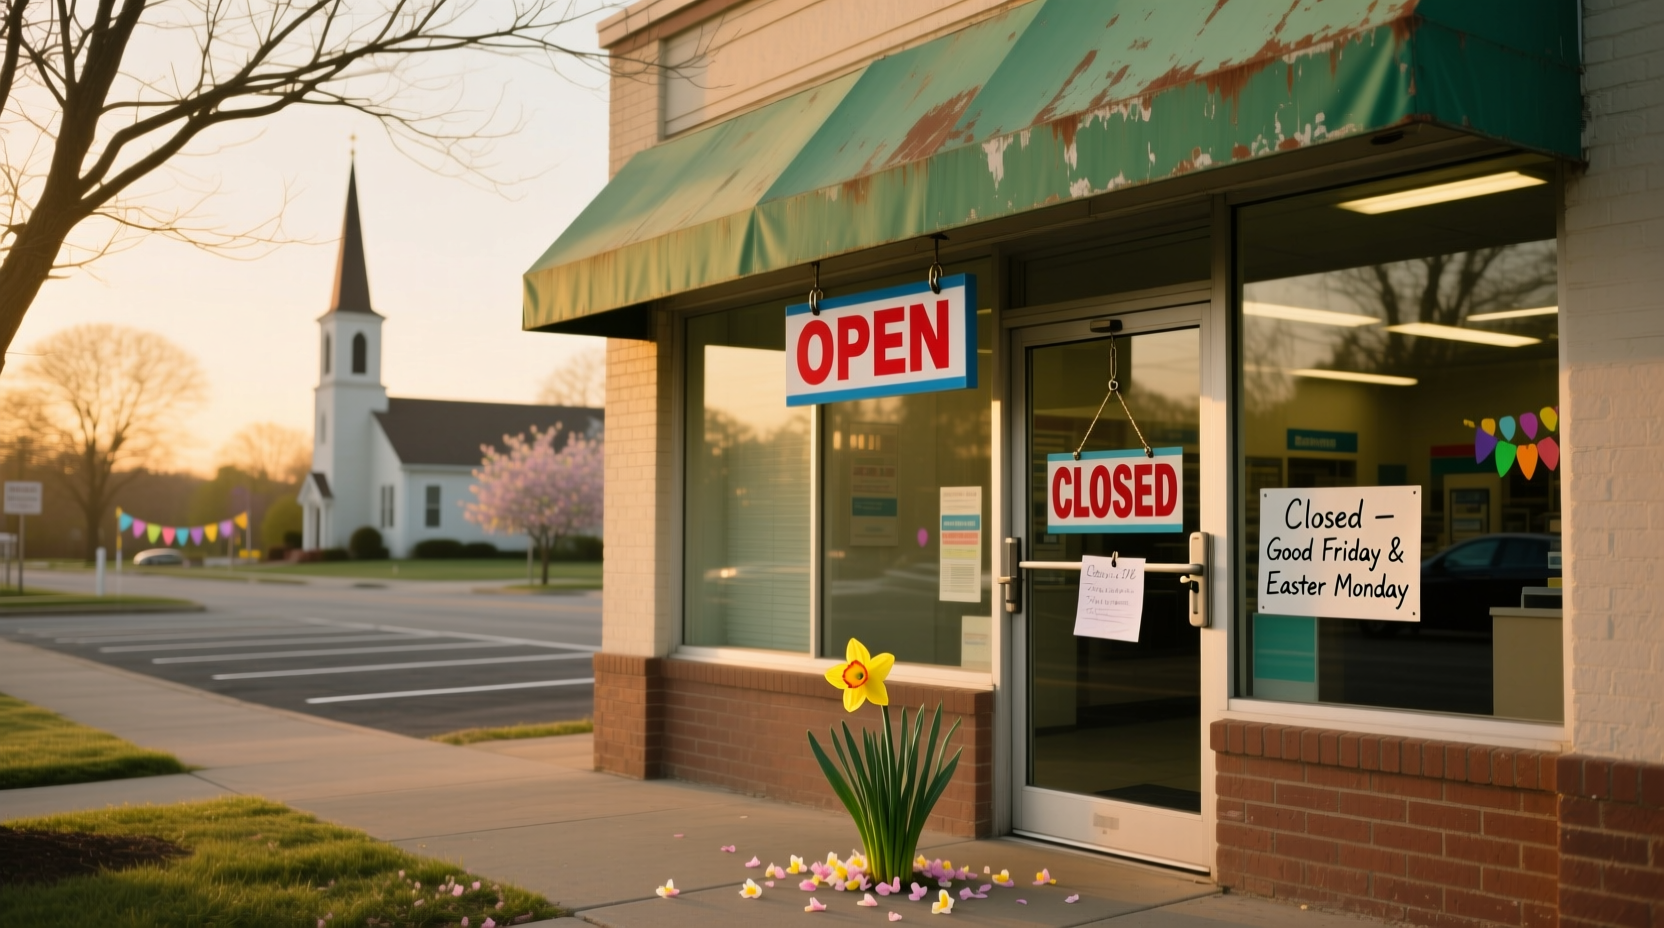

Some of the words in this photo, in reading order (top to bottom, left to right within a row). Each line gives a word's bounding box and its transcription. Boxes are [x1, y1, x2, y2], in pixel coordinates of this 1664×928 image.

[796, 299, 950, 386] OPEN
[1052, 463, 1178, 519] CLOSED
[1285, 498, 1364, 529] Closed
[1266, 536, 1313, 562] Good
[1322, 537, 1381, 572] Friday
[1388, 536, 1404, 563] &
[1266, 571, 1327, 596] Easter
[1334, 573, 1409, 610] Monday
